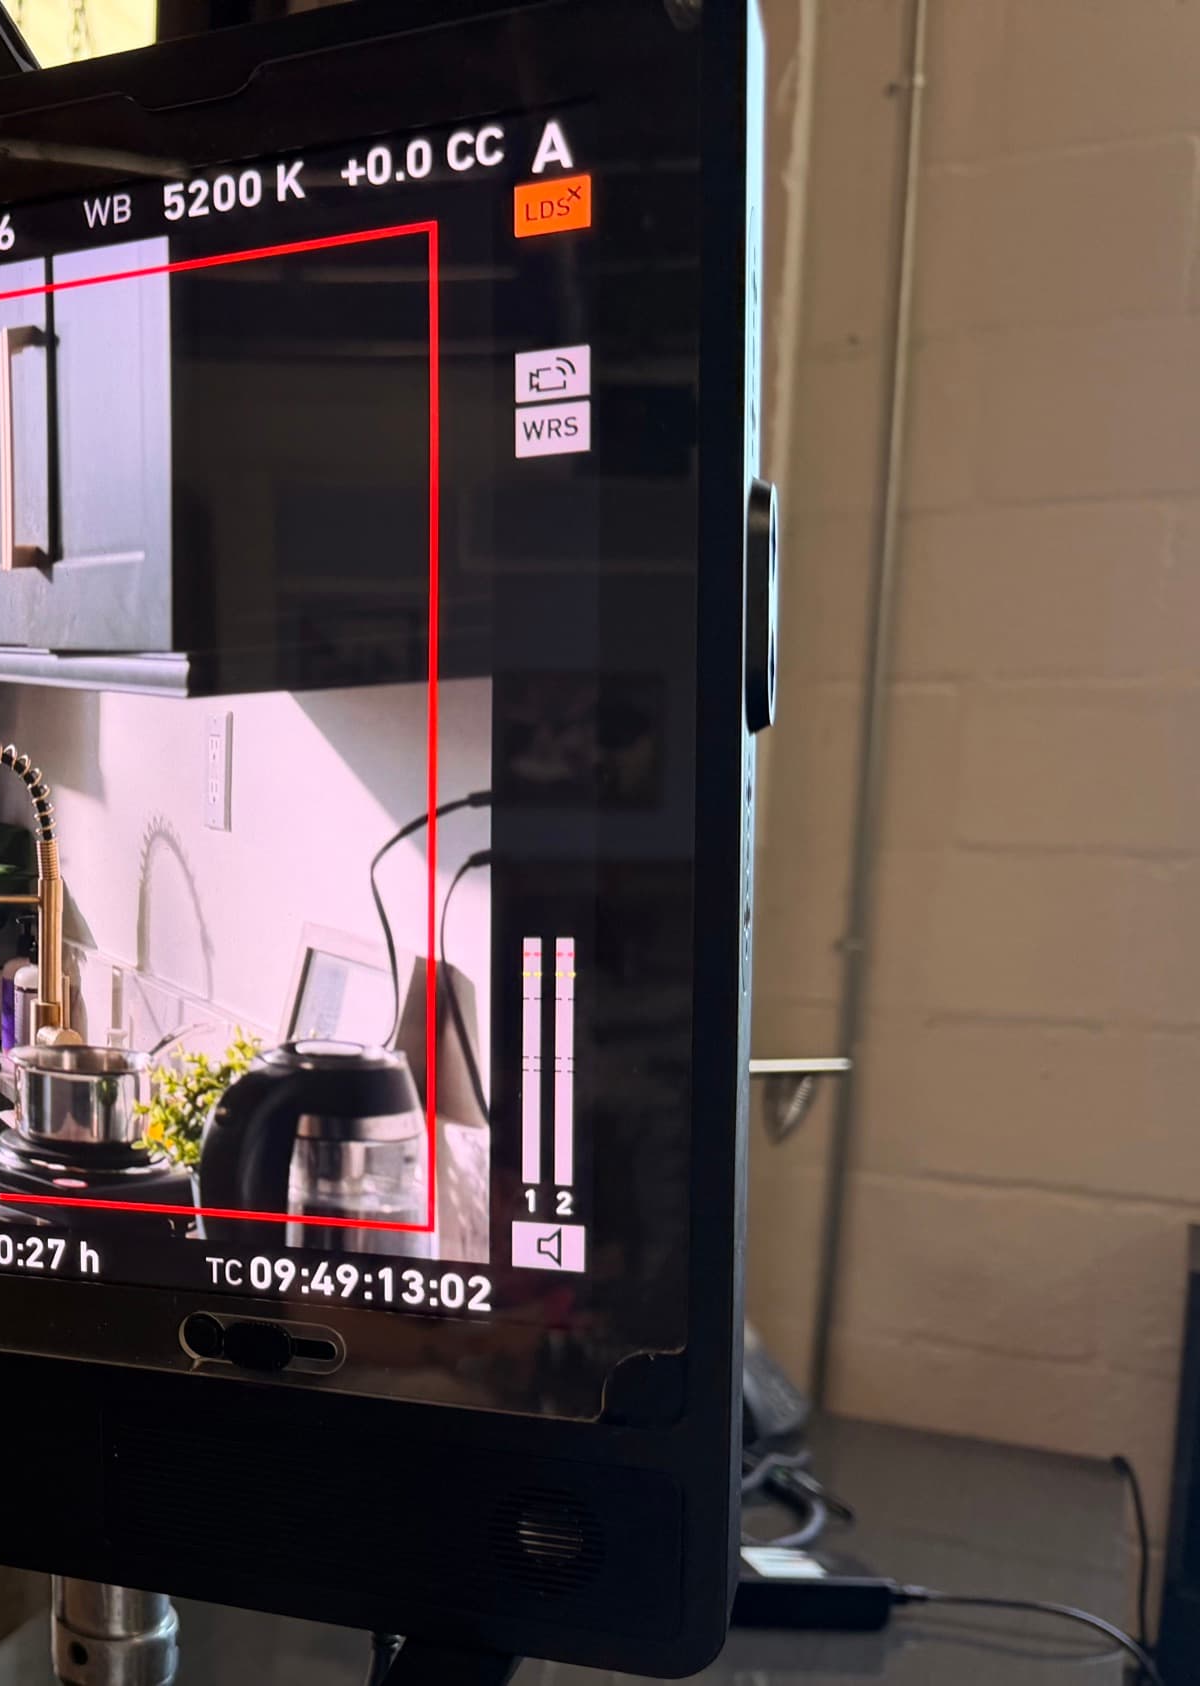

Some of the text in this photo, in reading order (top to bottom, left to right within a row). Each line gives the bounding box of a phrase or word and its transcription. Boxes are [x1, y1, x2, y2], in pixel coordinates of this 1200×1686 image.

[531, 120, 574, 174] A
[83, 125, 505, 229] WB 5200 K +0.0 CC
[523, 416, 578, 442] WRS
[524, 1188, 536, 1214] 1
[555, 1190, 574, 1216] 2
[79, 1240, 100, 1274] h
[205, 1255, 492, 1312] TC 09:49:13:02
